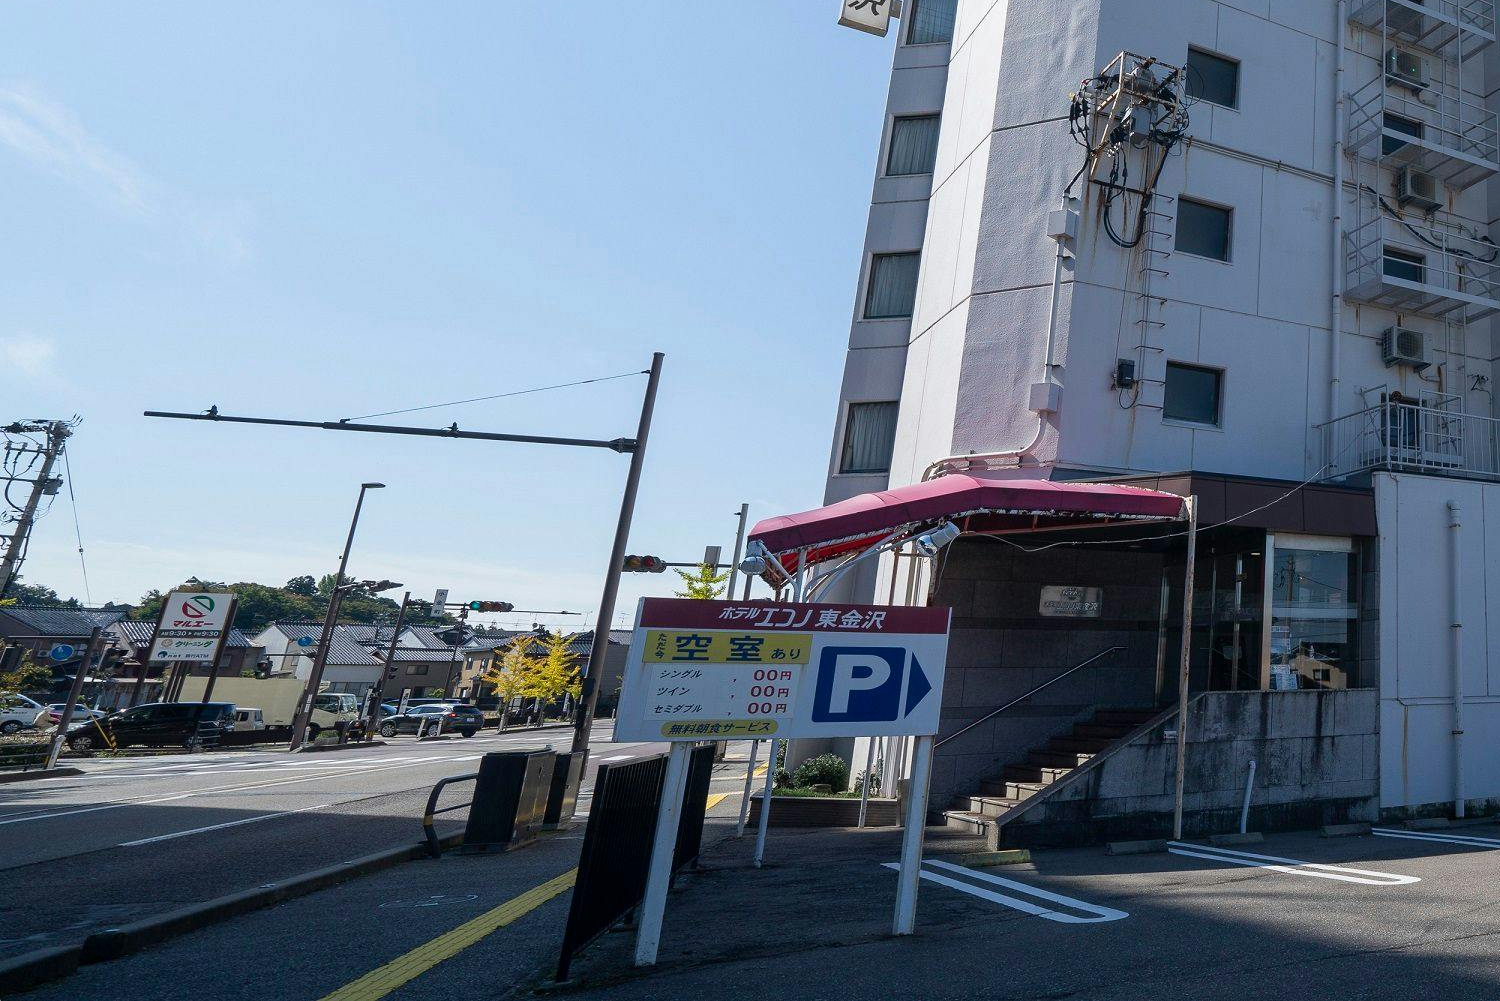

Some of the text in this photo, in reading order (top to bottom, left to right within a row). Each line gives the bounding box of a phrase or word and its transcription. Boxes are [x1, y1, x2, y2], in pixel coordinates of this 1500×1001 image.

[173, 620, 214, 628] マルエー
[175, 640, 214, 648] クリーニング
[660, 669, 703, 680] シングル
[828, 653, 892, 714] P
[656, 686, 690, 696] ツイン
[654, 703, 703, 714] セミダブル
[668, 722, 771, 735] 無料朝食サービス
